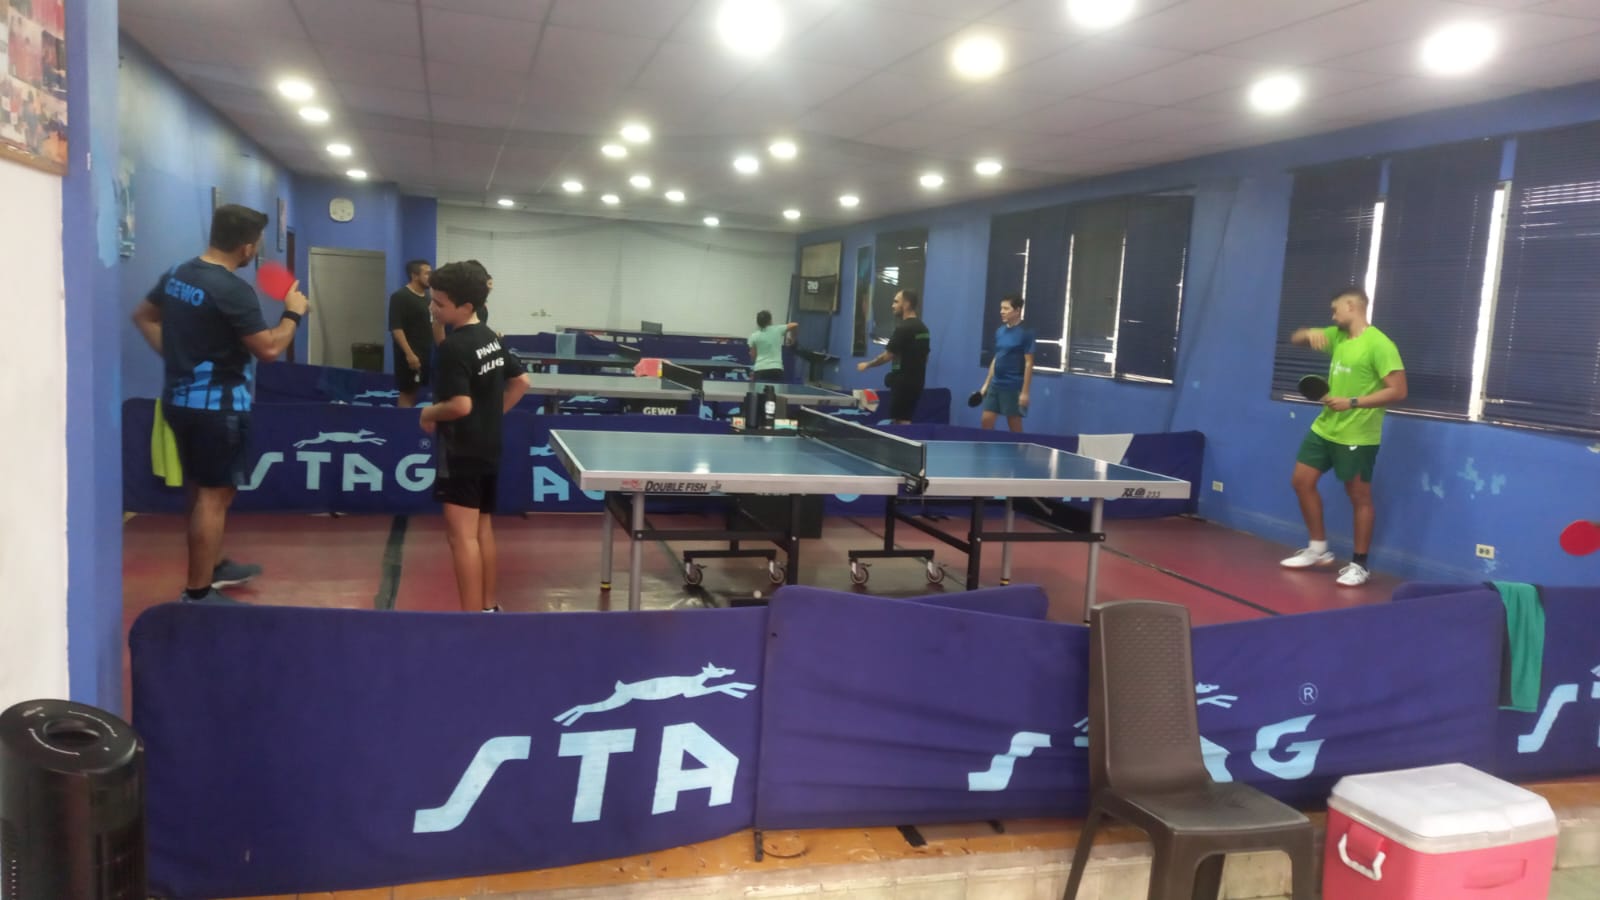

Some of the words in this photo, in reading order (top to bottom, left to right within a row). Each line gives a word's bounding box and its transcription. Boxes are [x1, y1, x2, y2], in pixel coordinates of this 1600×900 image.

[165, 278, 205, 306] GEWO
[642, 406, 677, 416] GEWO
[237, 451, 436, 492] STAG
[645, 480, 684, 492] DOUBLE
[685, 482, 708, 492] FISH
[412, 722, 740, 833] STA
